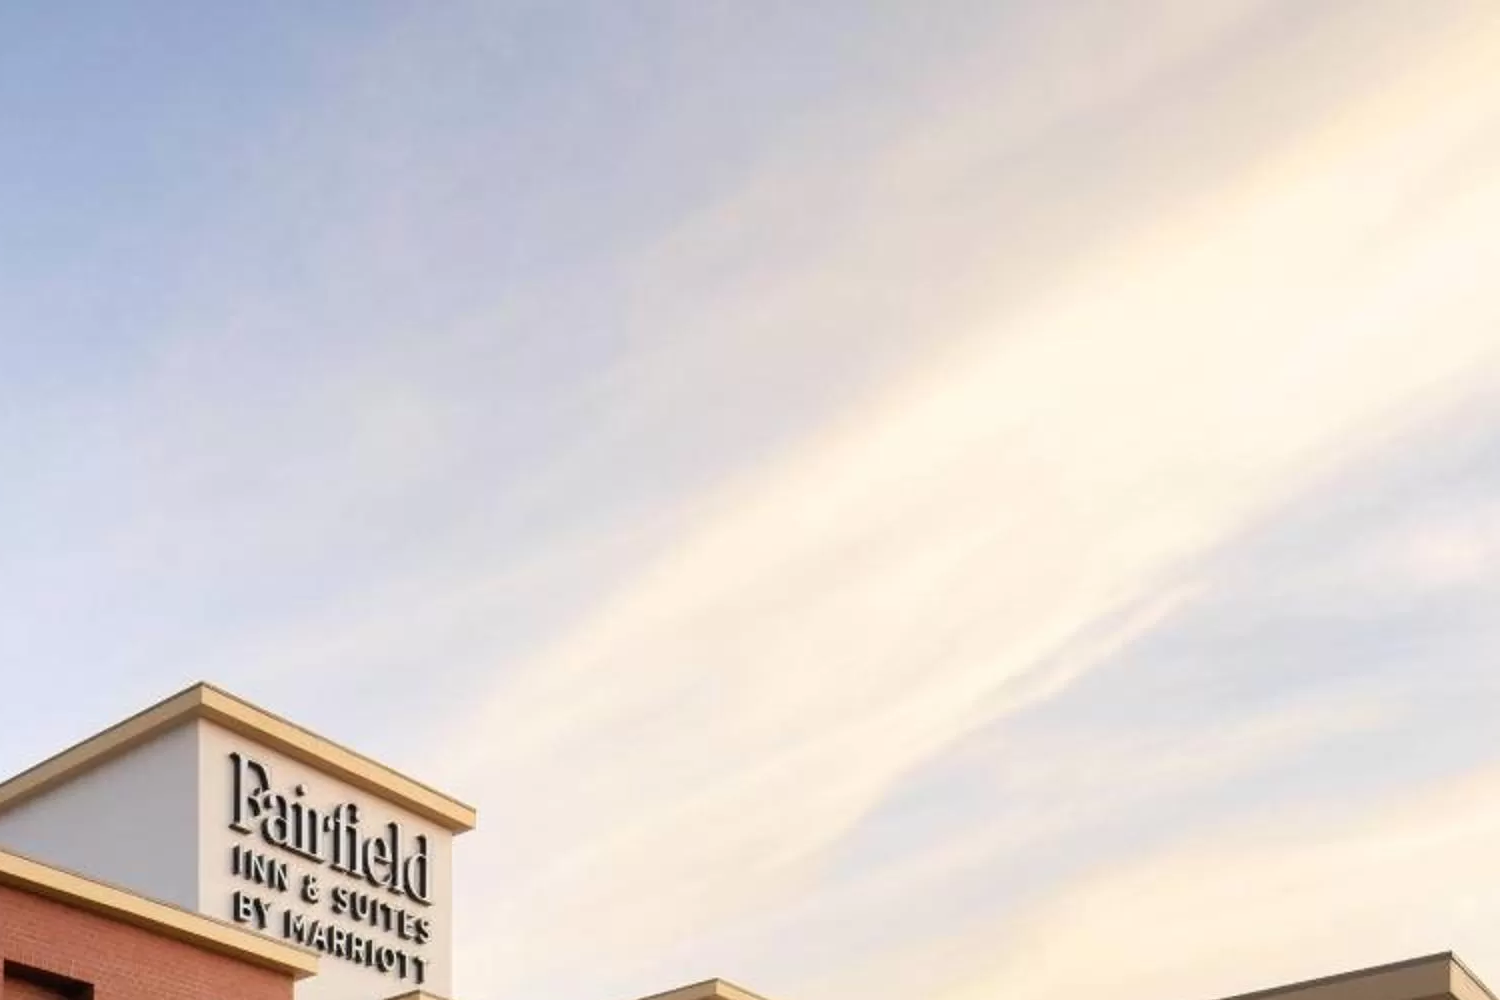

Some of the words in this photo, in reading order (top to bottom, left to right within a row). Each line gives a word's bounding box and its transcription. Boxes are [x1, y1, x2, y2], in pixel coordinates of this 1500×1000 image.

[228, 752, 433, 906] Fairfield
[230, 843, 290, 892] INN
[301, 873, 321, 904] &
[331, 885, 433, 945] SUITES
[232, 890, 271, 930] BY
[283, 909, 429, 985] MARRIOTT
